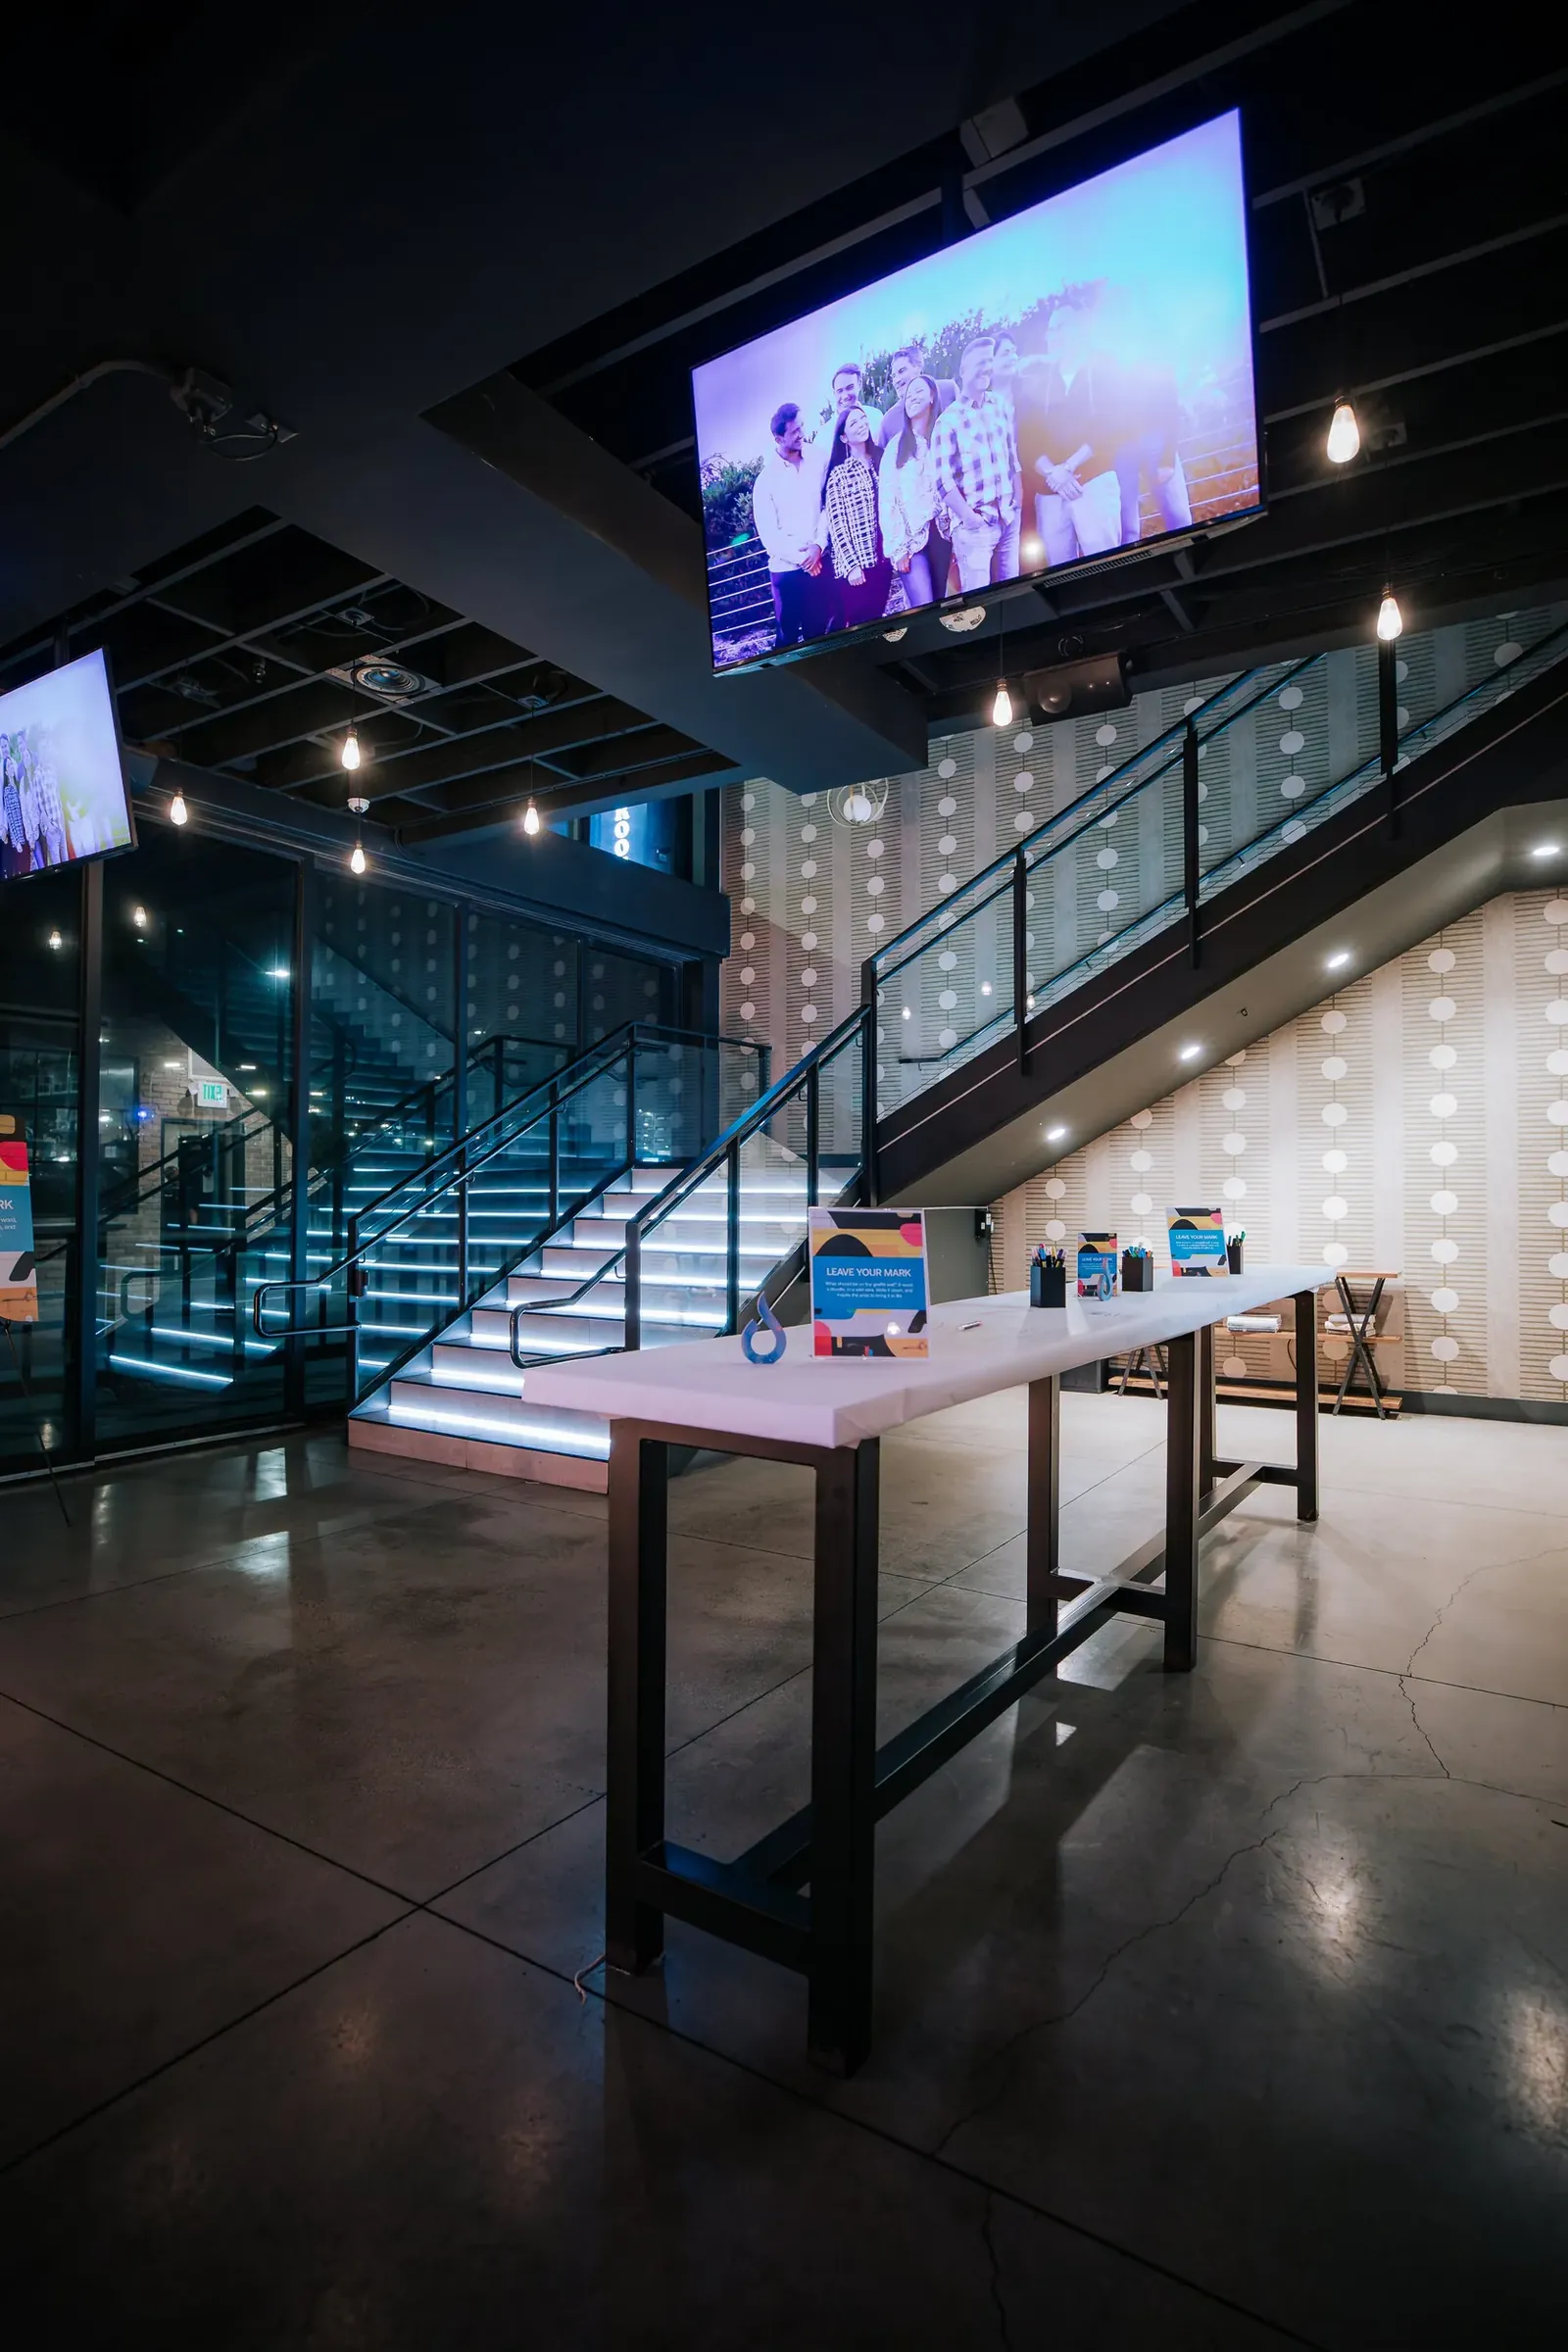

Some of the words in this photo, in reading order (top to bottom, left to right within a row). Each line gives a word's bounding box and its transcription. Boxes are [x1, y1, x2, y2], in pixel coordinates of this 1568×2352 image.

[826, 1267, 855, 1277] LEAVE
[856, 1268, 882, 1277] YOUR
[884, 1268, 911, 1277] MARK
